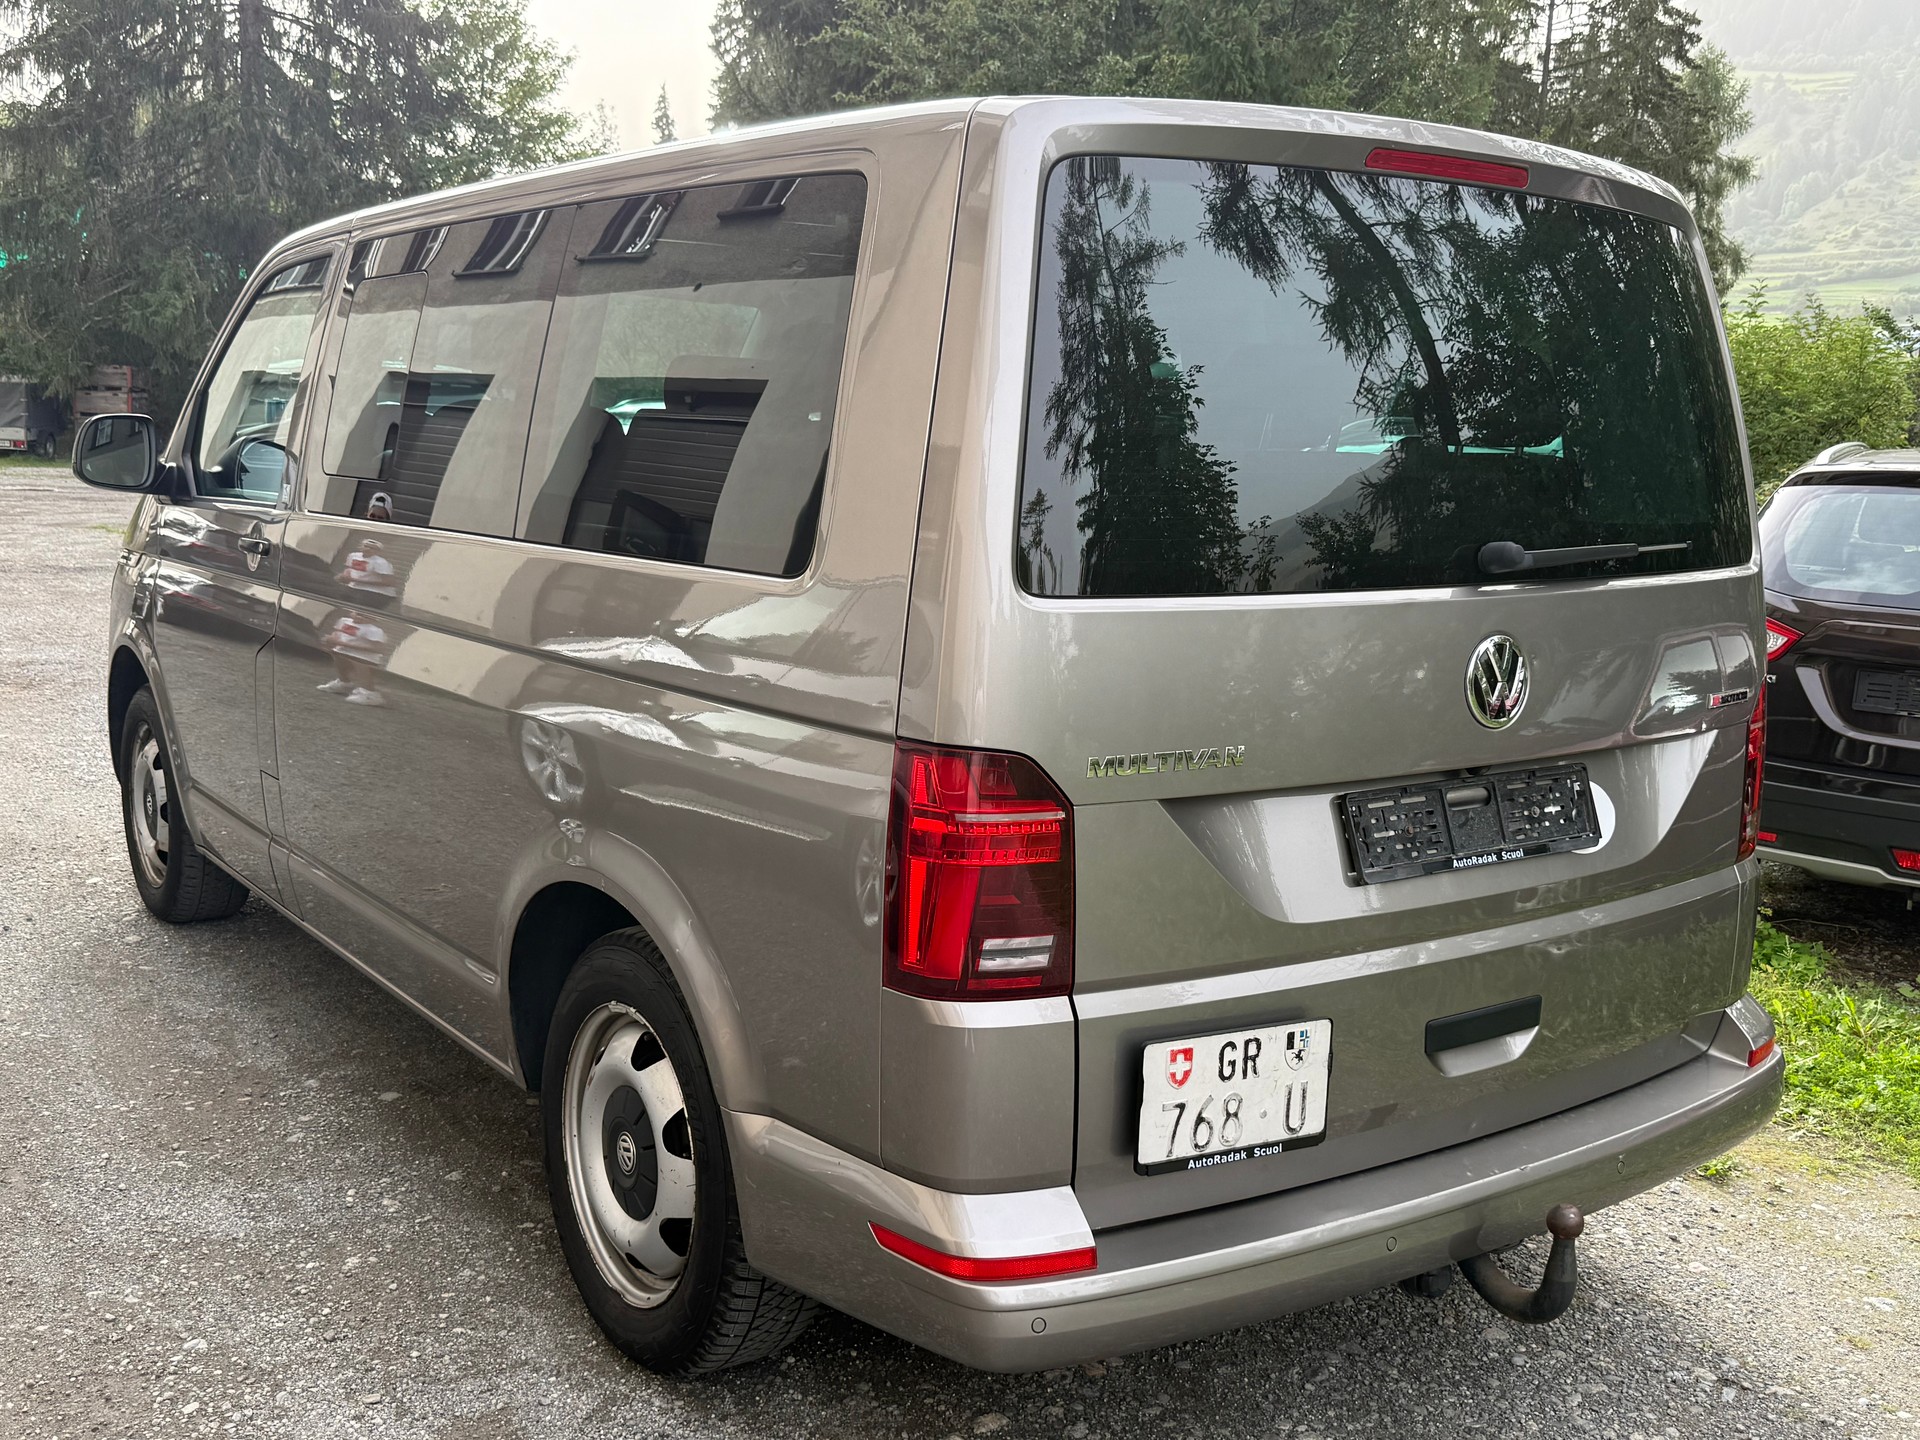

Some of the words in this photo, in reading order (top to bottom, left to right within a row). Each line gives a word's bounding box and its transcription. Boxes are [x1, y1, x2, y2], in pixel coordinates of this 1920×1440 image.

[1086, 745, 1245, 778] MULTIVAN
[1453, 853, 1498, 869] AutoRadak
[1501, 848, 1524, 860] Scuol
[1218, 1037, 1262, 1082] GR
[1162, 1092, 1243, 1157] 768
[1283, 1081, 1309, 1135] U
[1187, 1150, 1247, 1169] AutoRadak
[1253, 1143, 1283, 1157] Scuol
